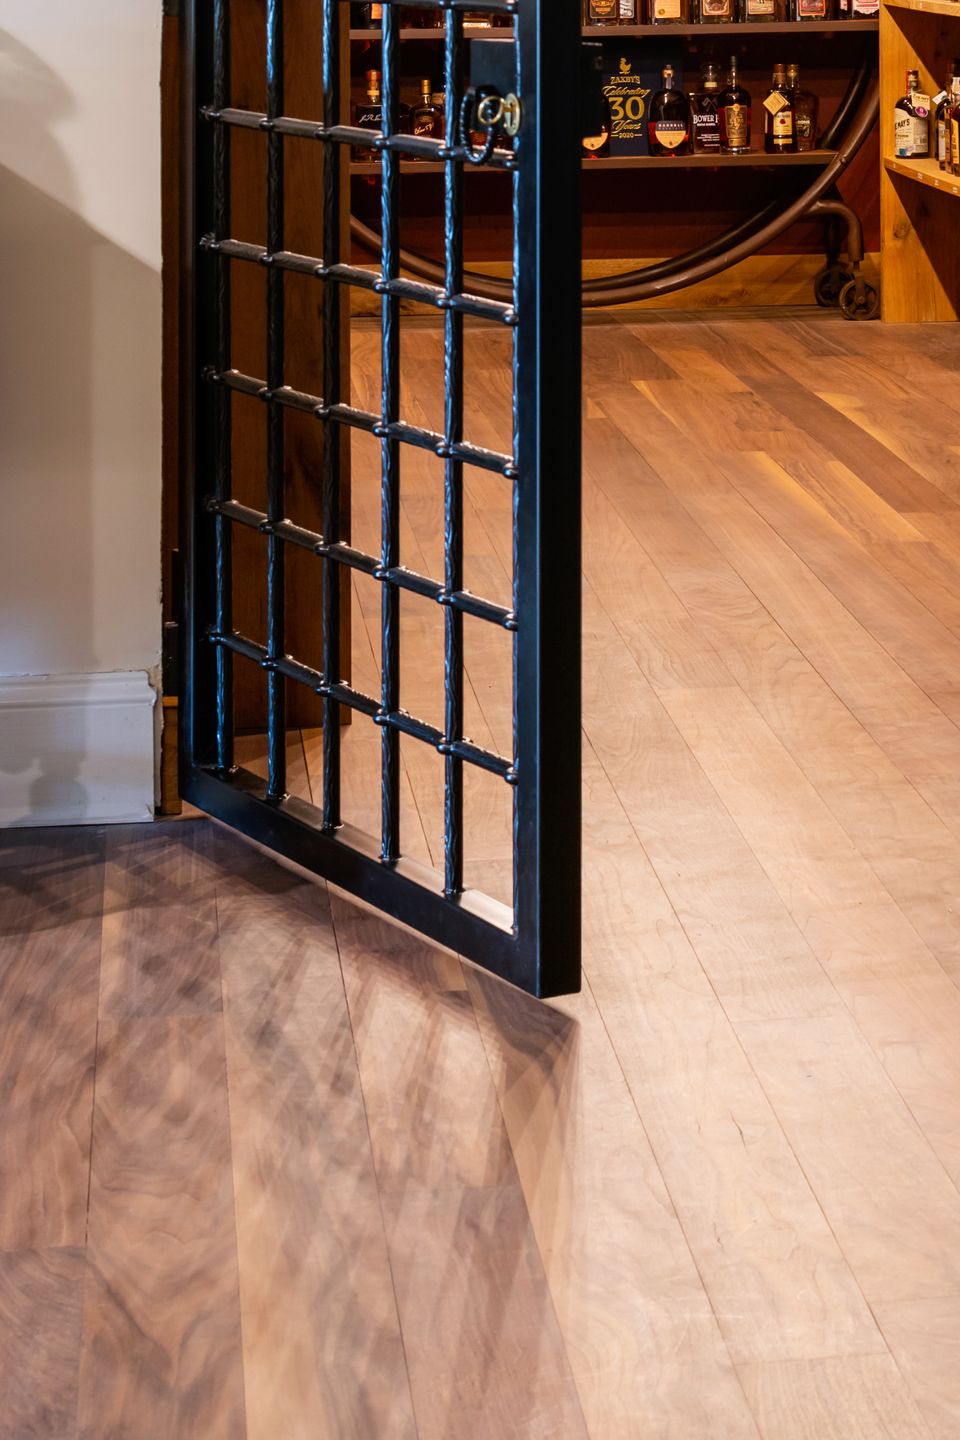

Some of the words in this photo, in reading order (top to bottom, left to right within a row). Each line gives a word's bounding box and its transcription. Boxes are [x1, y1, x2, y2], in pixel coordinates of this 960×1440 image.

[610, 75, 641, 85] ZAXBY'S
[602, 85, 651, 98] Celebrating
[608, 95, 645, 121] 30
[693, 114, 715, 125] BOWER
[611, 119, 642, 134] Years
